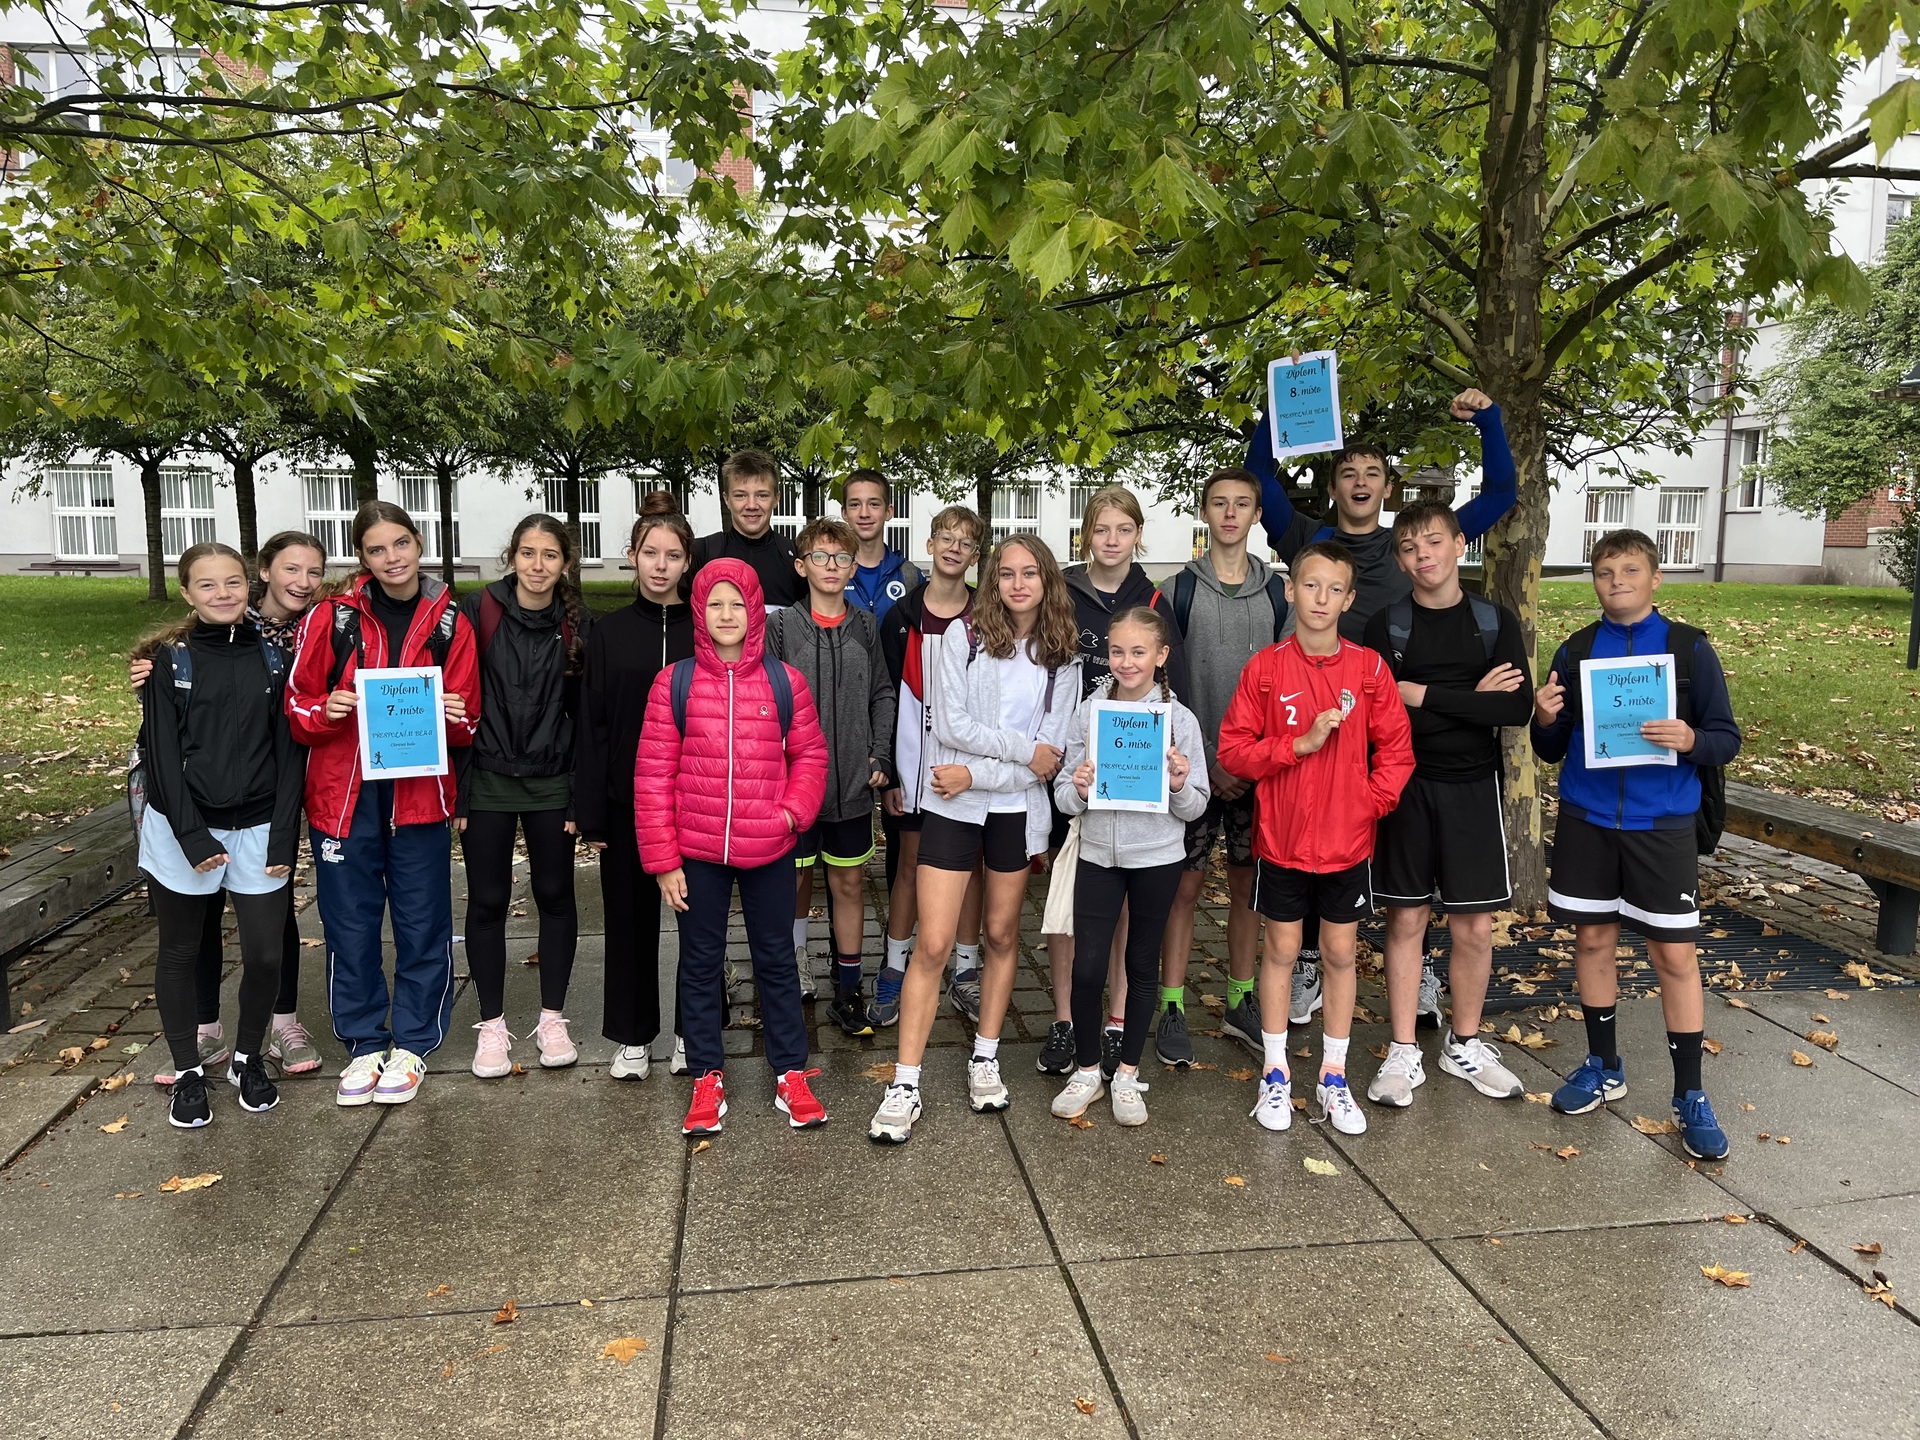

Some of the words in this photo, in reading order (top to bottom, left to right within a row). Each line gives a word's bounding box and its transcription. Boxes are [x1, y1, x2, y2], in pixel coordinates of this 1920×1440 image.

[1286, 366, 1317, 380] Diplom
[1290, 387, 1300, 398] 8.
[1301, 385, 1322, 396] místo
[1608, 672, 1649, 688] Diplom
[380, 682, 418, 698] Diplom
[1613, 696, 1626, 708] 5.
[1628, 696, 1656, 706] místo
[386, 705, 398, 716] 7.
[400, 706, 424, 716] místo
[1286, 705, 1298, 726] 2
[1112, 716, 1148, 730] Diplom
[1114, 737, 1126, 748] 6.
[1128, 739, 1152, 749] místo
